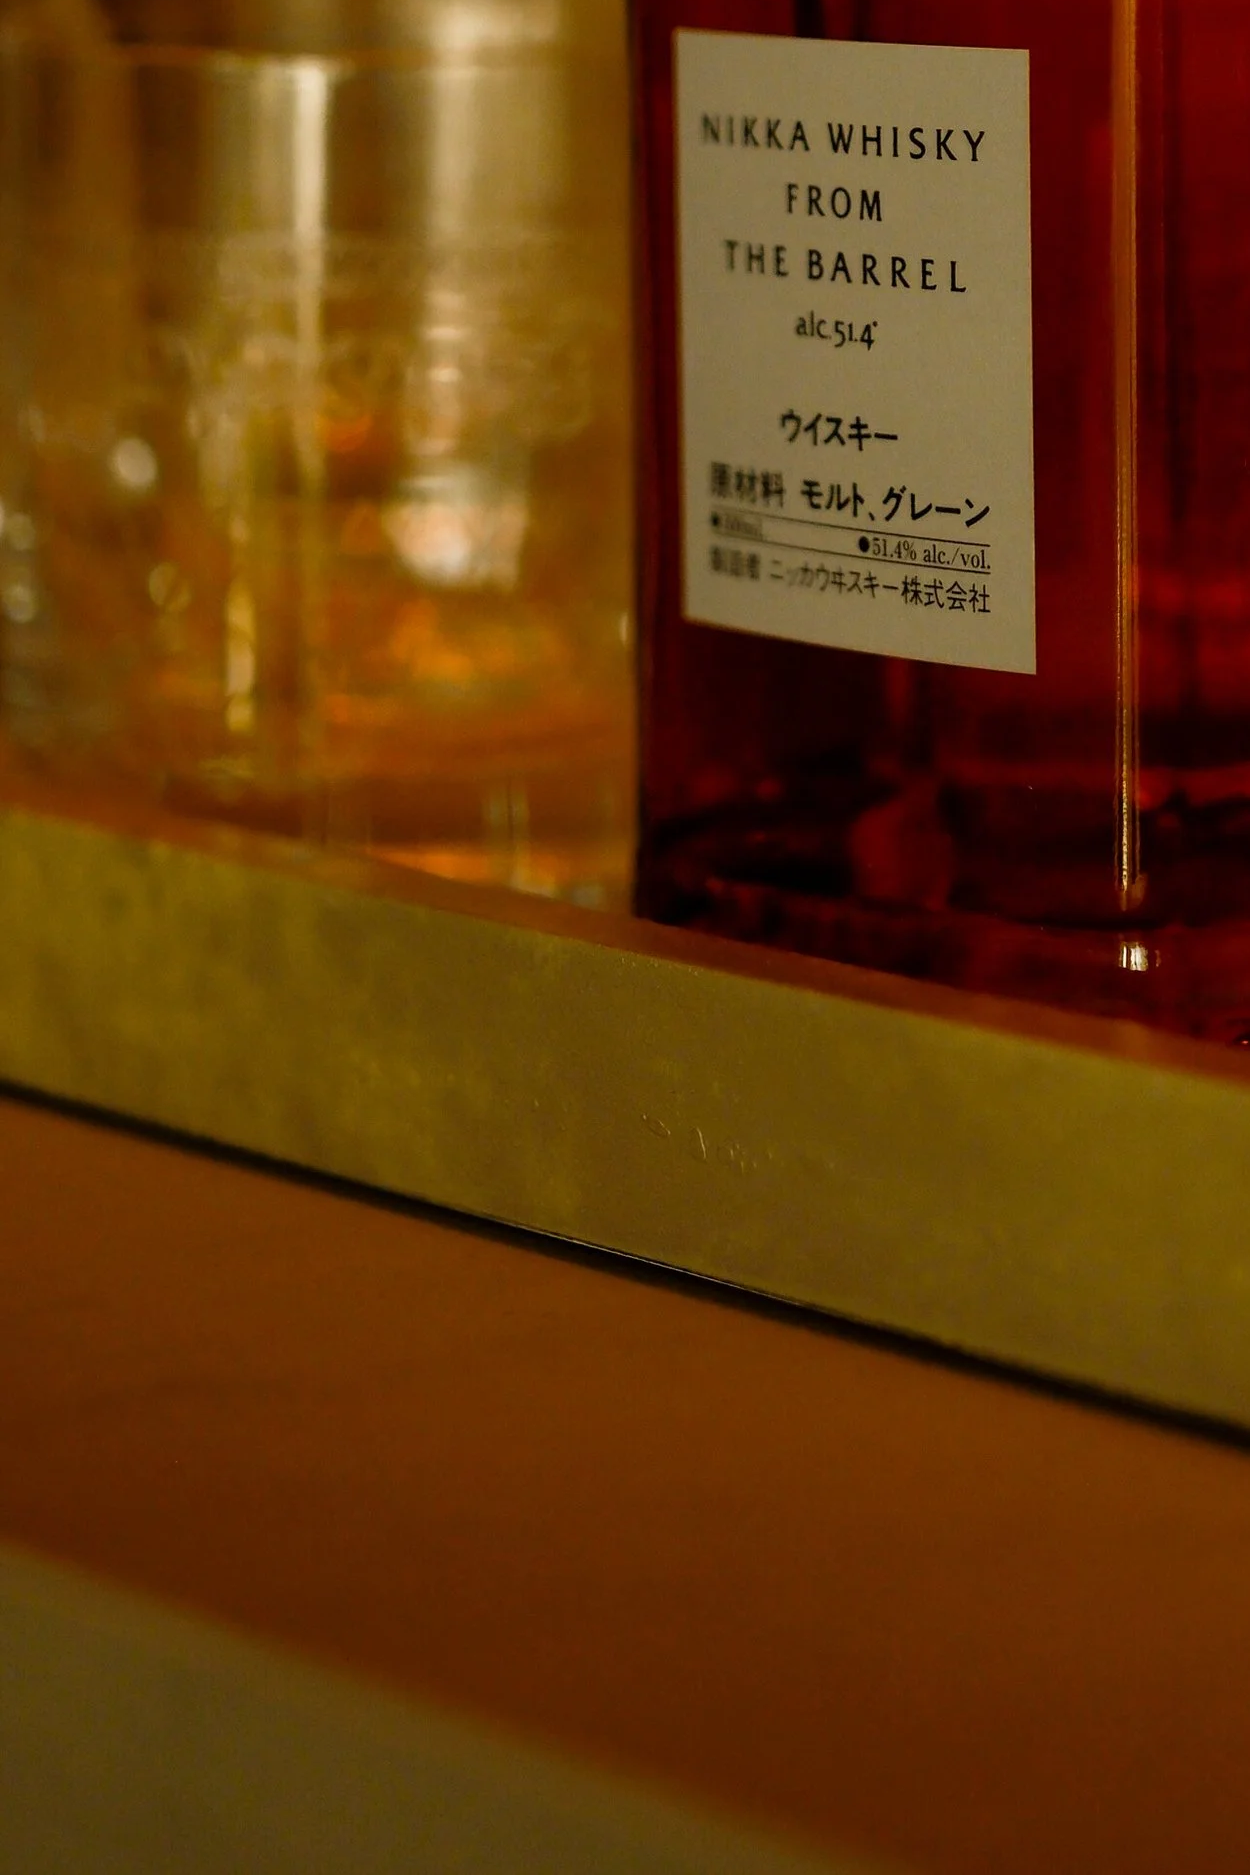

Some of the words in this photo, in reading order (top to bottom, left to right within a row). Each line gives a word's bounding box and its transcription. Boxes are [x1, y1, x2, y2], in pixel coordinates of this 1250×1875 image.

[702, 113, 810, 152] NIKKA
[827, 122, 986, 162] WHISKY
[785, 183, 883, 222] FROM
[723, 239, 790, 277] THE
[807, 249, 967, 293] BARREL
[780, 408, 899, 451] ウイスキー
[922, 543, 991, 570] alc./vol.
